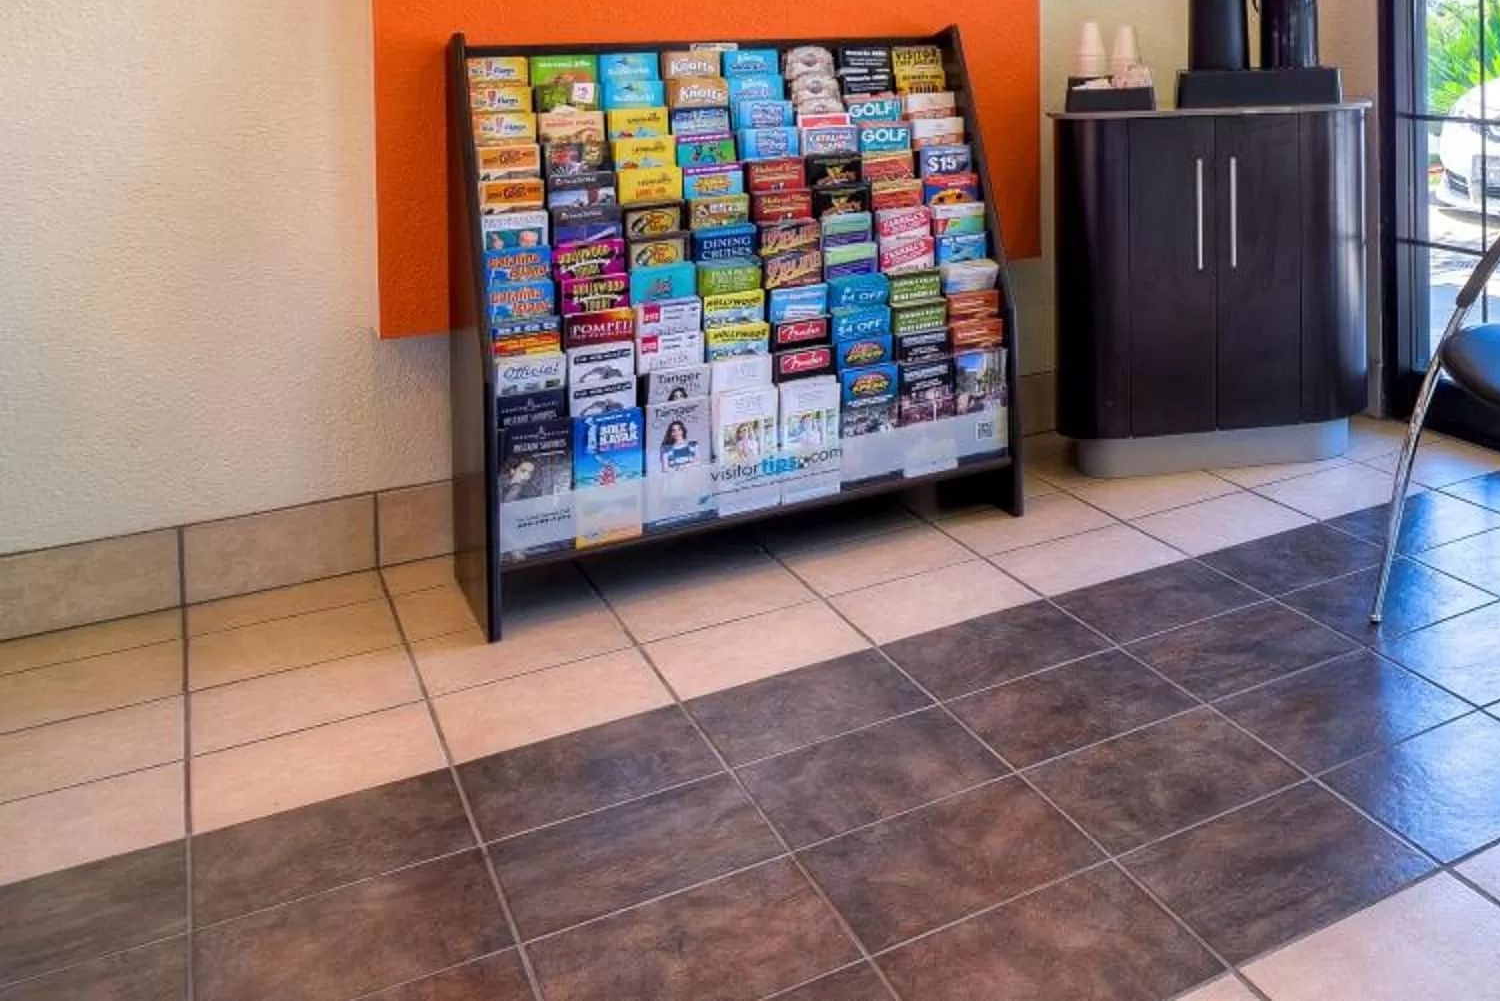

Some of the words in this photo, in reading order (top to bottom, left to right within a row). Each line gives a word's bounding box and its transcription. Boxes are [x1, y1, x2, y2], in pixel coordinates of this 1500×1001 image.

[848, 100, 895, 118] GOLF
[861, 127, 908, 142] GOLF
[703, 236, 752, 250] DINING
[701, 247, 753, 260] CRUISES
[573, 320, 632, 335] POMPEII
[857, 319, 881, 332] OFF
